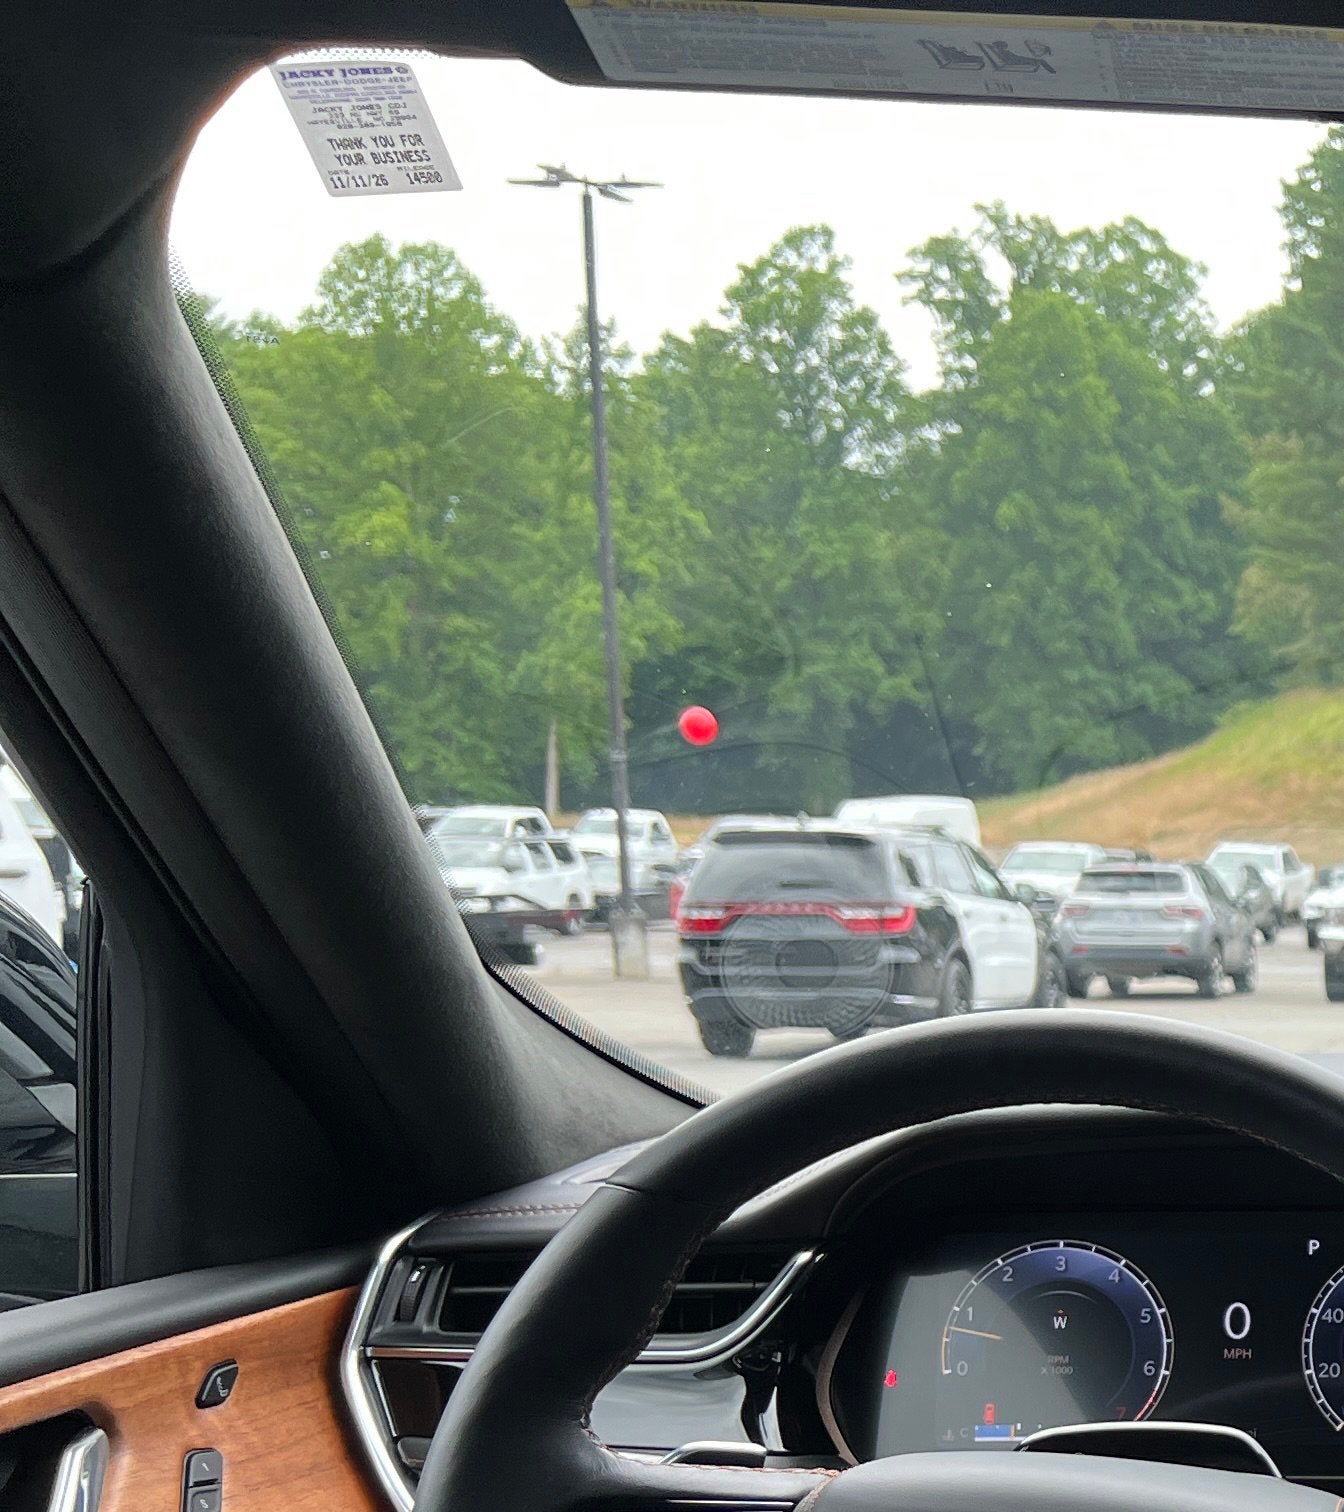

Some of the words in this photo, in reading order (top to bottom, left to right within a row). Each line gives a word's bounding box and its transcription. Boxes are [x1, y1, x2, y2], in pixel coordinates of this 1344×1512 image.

[278, 68, 334, 80] JACKY
[342, 66, 393, 78] JONES
[326, 137, 368, 152] THANK
[371, 135, 395, 149] YOU
[401, 133, 425, 147] FOR
[335, 152, 366, 167] YOUR
[372, 149, 431, 165] BUSINESS
[330, 174, 389, 189] 11/11/26
[1308, 1240, 1320, 1255] P
[1056, 1256, 1066, 1272] 3
[1003, 1266, 1014, 1282] 2
[1108, 1268, 1120, 1284] 4
[967, 1307, 974, 1321] 1
[1140, 1308, 1152, 1324] 5
[1223, 1302, 1252, 1340] 0
[1322, 1308, 1344, 1324] 40
[1053, 1316, 1067, 1329] W
[1047, 1354, 1070, 1364] RPM
[1223, 1348, 1252, 1359] MPH
[957, 1361, 969, 1376] 0
[1050, 1366, 1073, 1375] 1000
[1143, 1360, 1156, 1376] 6
[1319, 1362, 1341, 1379] 20
